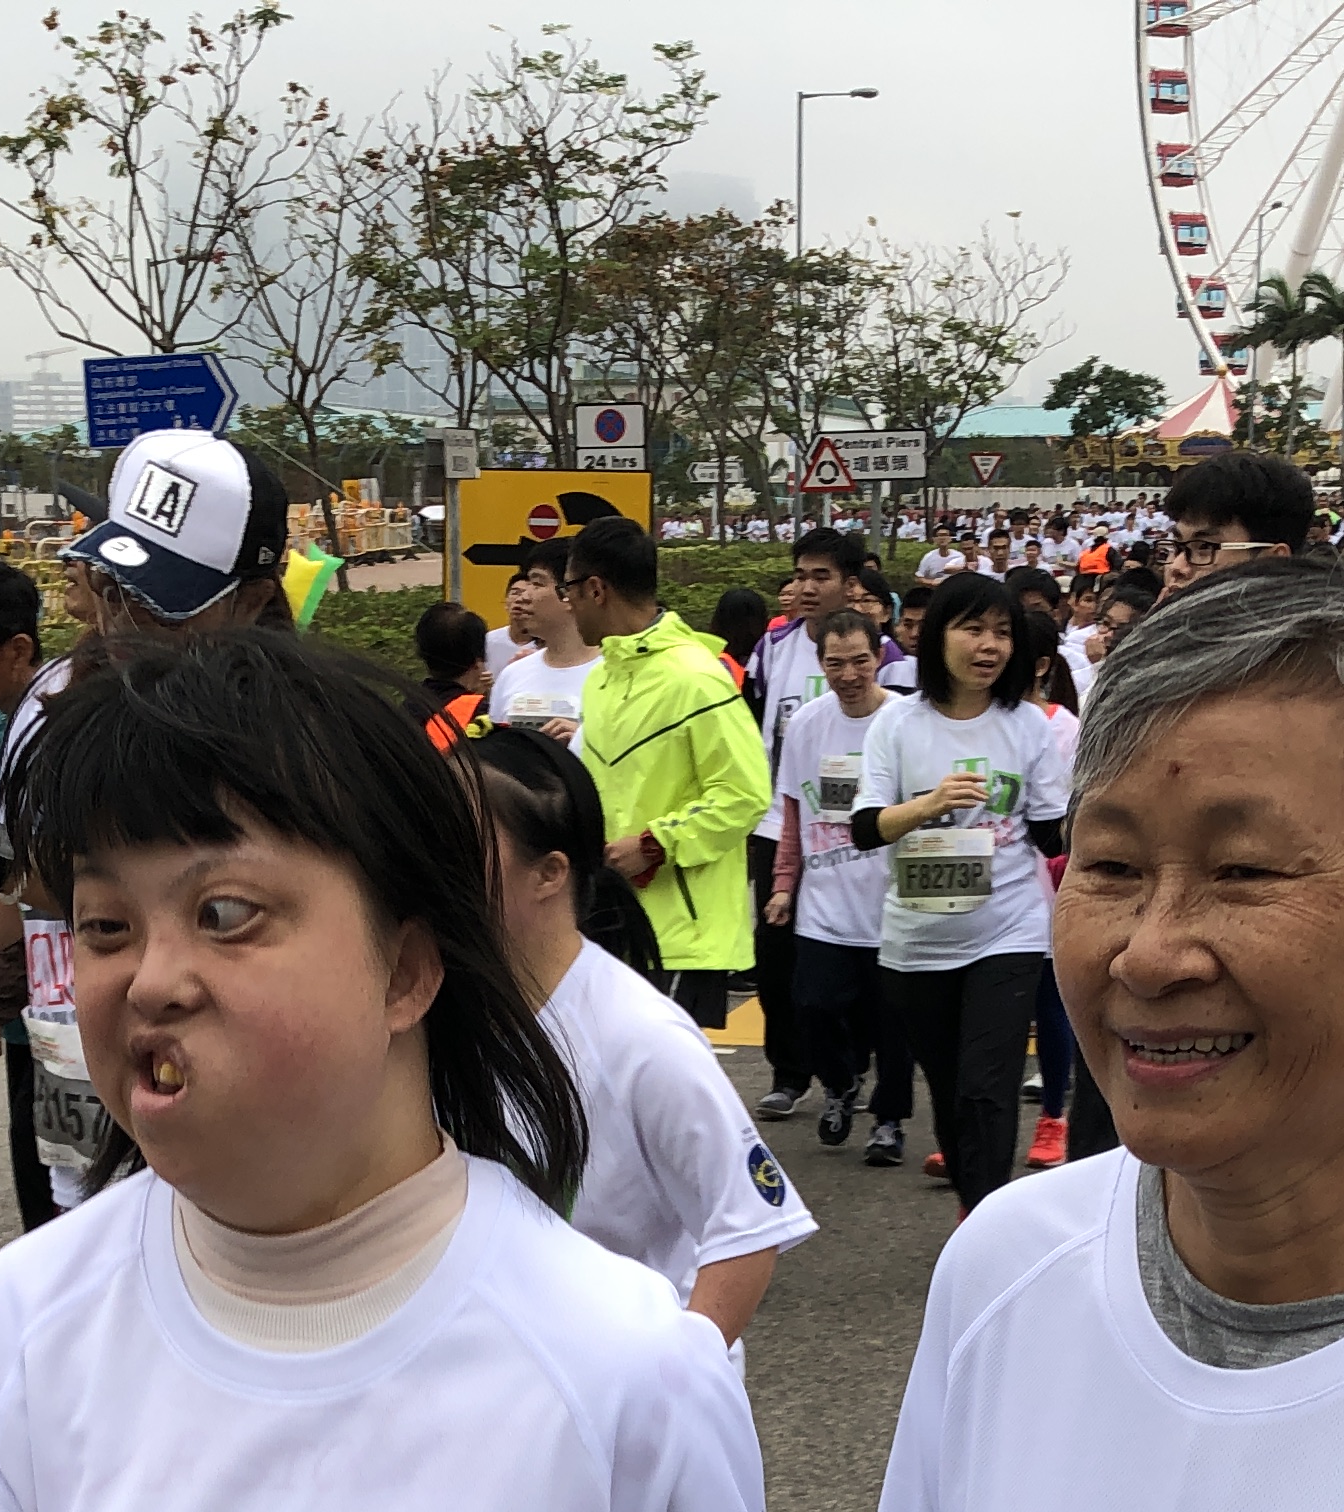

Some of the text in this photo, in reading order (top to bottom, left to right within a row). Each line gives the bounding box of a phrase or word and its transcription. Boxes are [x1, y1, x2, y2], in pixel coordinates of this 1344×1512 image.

[834, 436, 920, 450] Central Piers
[584, 456, 638, 469] 24 hrs
[136, 469, 182, 529] LA
[907, 862, 984, 890] F8273P
